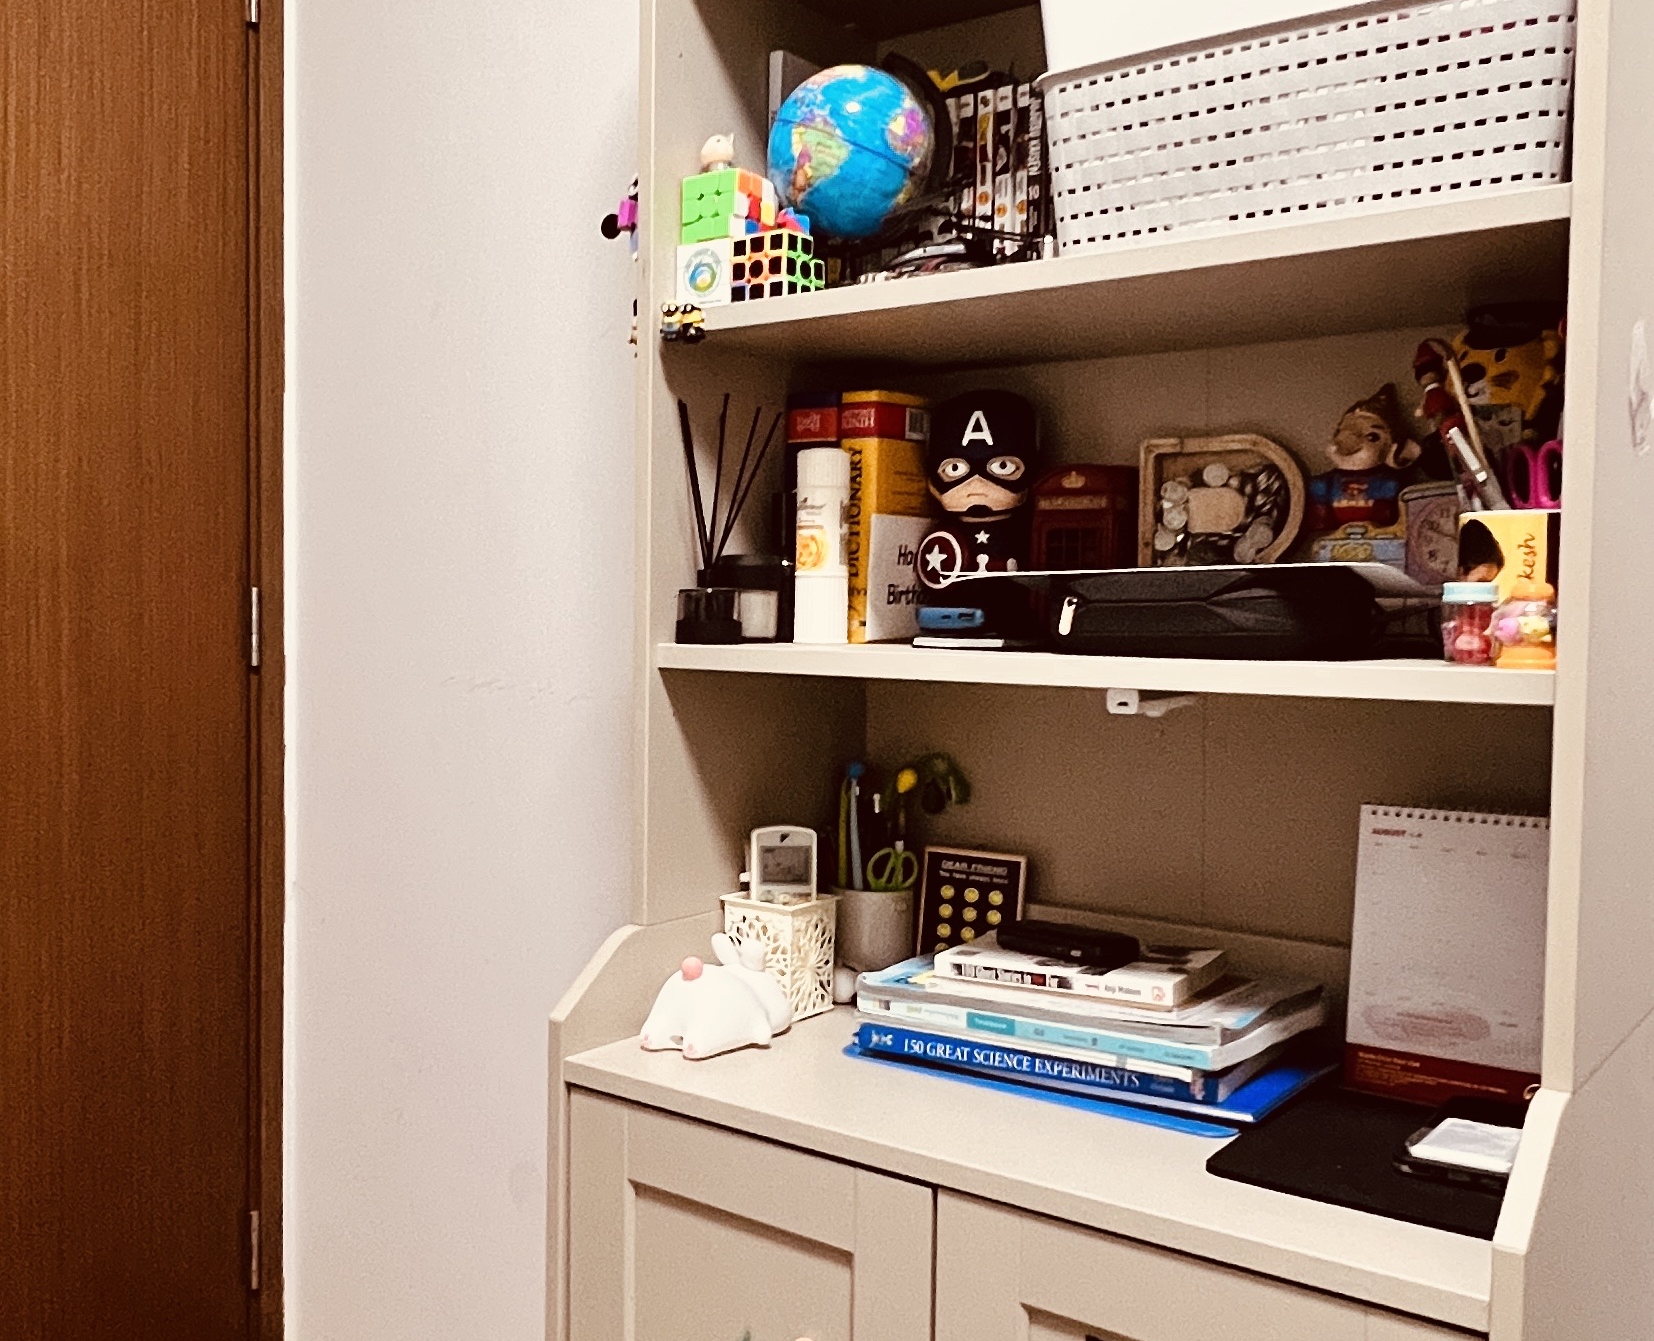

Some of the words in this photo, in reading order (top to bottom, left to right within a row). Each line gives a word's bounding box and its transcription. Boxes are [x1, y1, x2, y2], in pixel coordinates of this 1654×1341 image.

[961, 410, 994, 447] A
[848, 446, 863, 578] DICTIONARY
[903, 1038, 925, 1055] 150
[926, 1043, 970, 1062] GREAT
[973, 1048, 1032, 1072] SCIENCE
[1034, 1057, 1141, 1088] EXPERIMENTS
